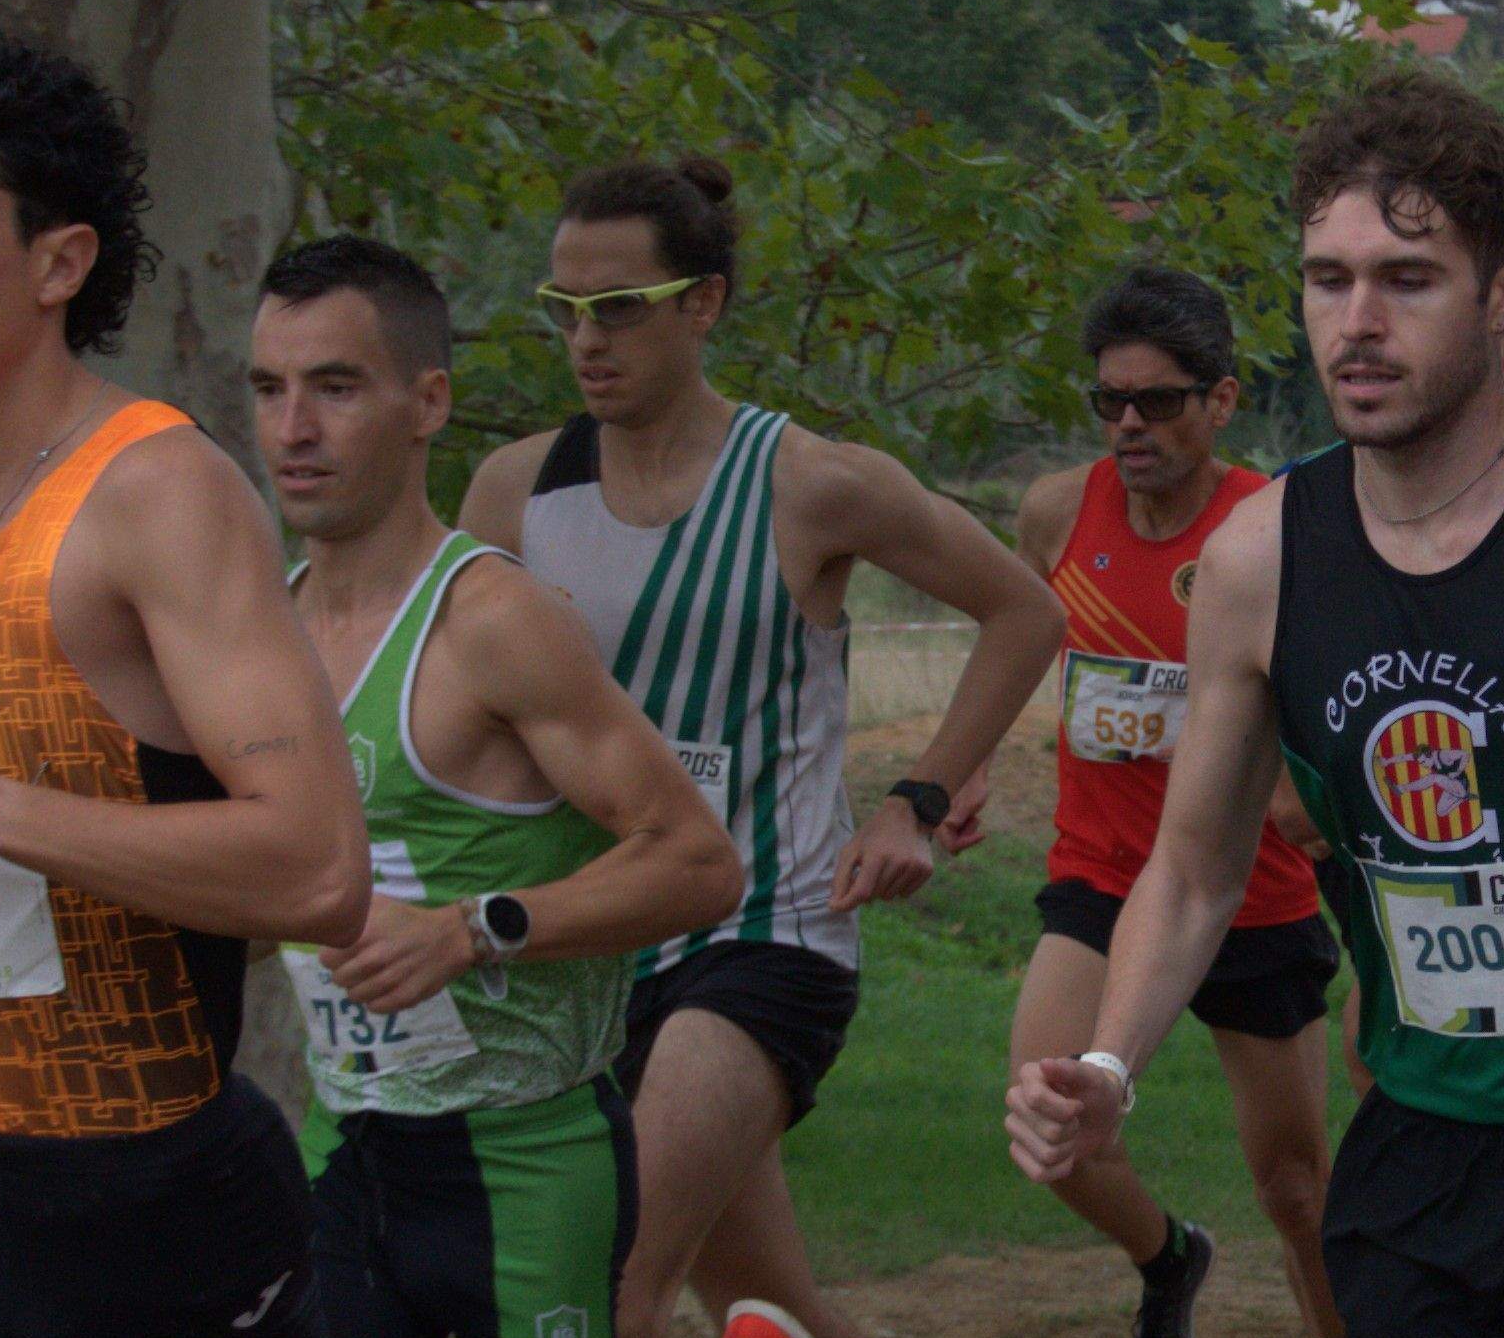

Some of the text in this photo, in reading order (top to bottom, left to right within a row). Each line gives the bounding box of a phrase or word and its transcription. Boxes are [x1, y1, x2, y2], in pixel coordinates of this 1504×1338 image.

[1151, 667, 1188, 690] CRO
[1094, 706, 1166, 749] 539
[312, 998, 410, 1046] 732
